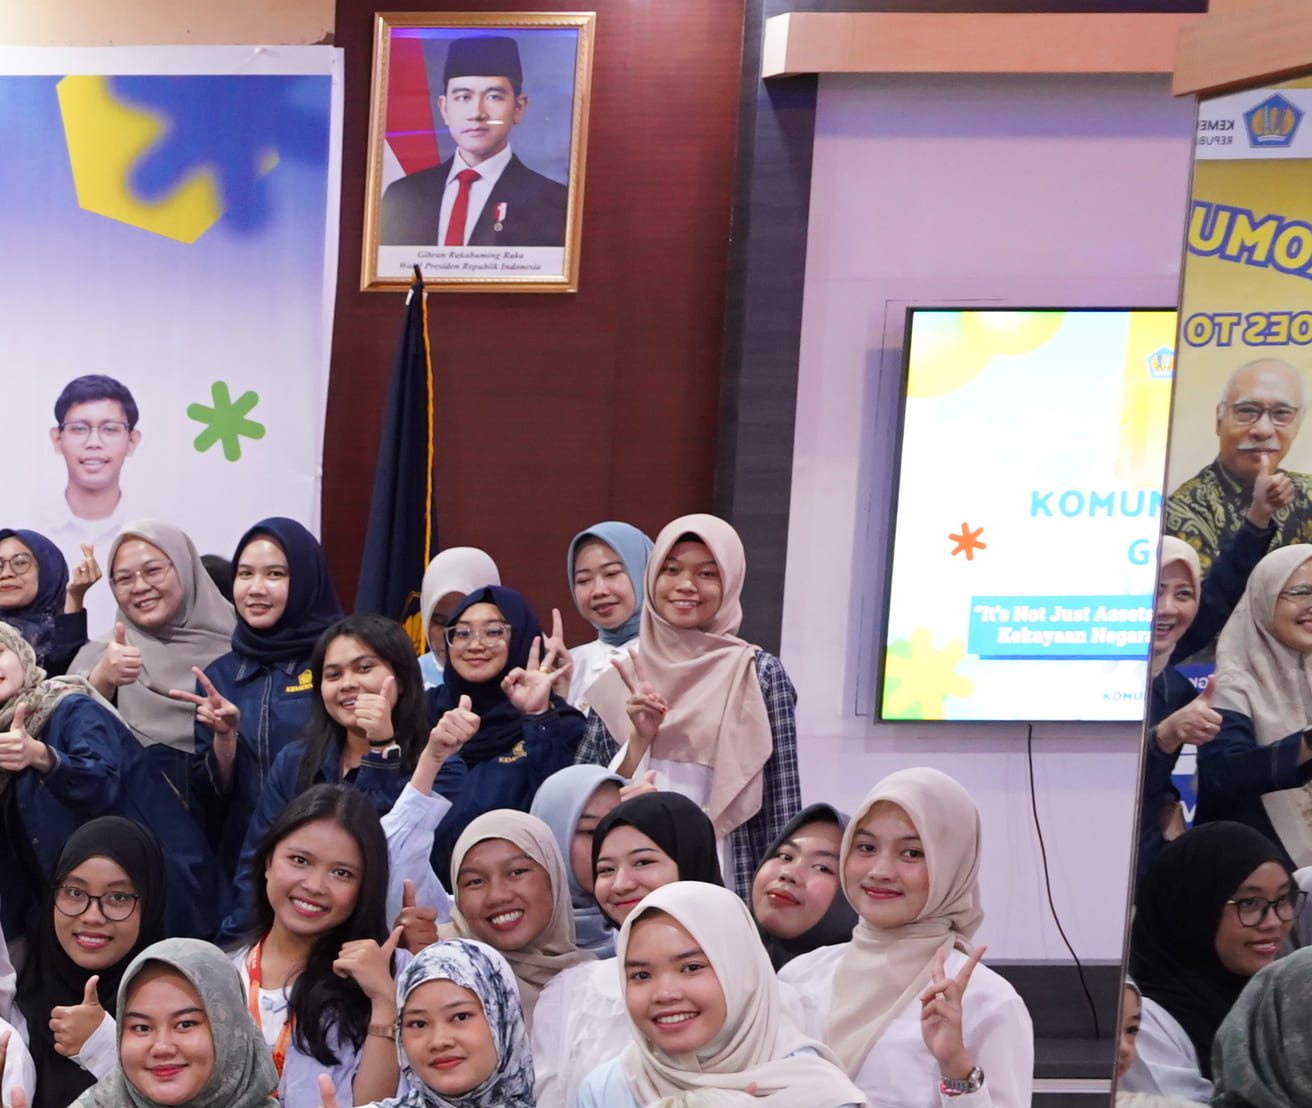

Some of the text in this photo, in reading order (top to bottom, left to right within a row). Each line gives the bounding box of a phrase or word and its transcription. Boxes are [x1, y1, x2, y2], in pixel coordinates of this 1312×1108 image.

[1128, 538, 1159, 565] G
[1013, 605, 1046, 622] Not
[1050, 605, 1091, 622] Just
[997, 627, 1088, 647] Kekayaan
